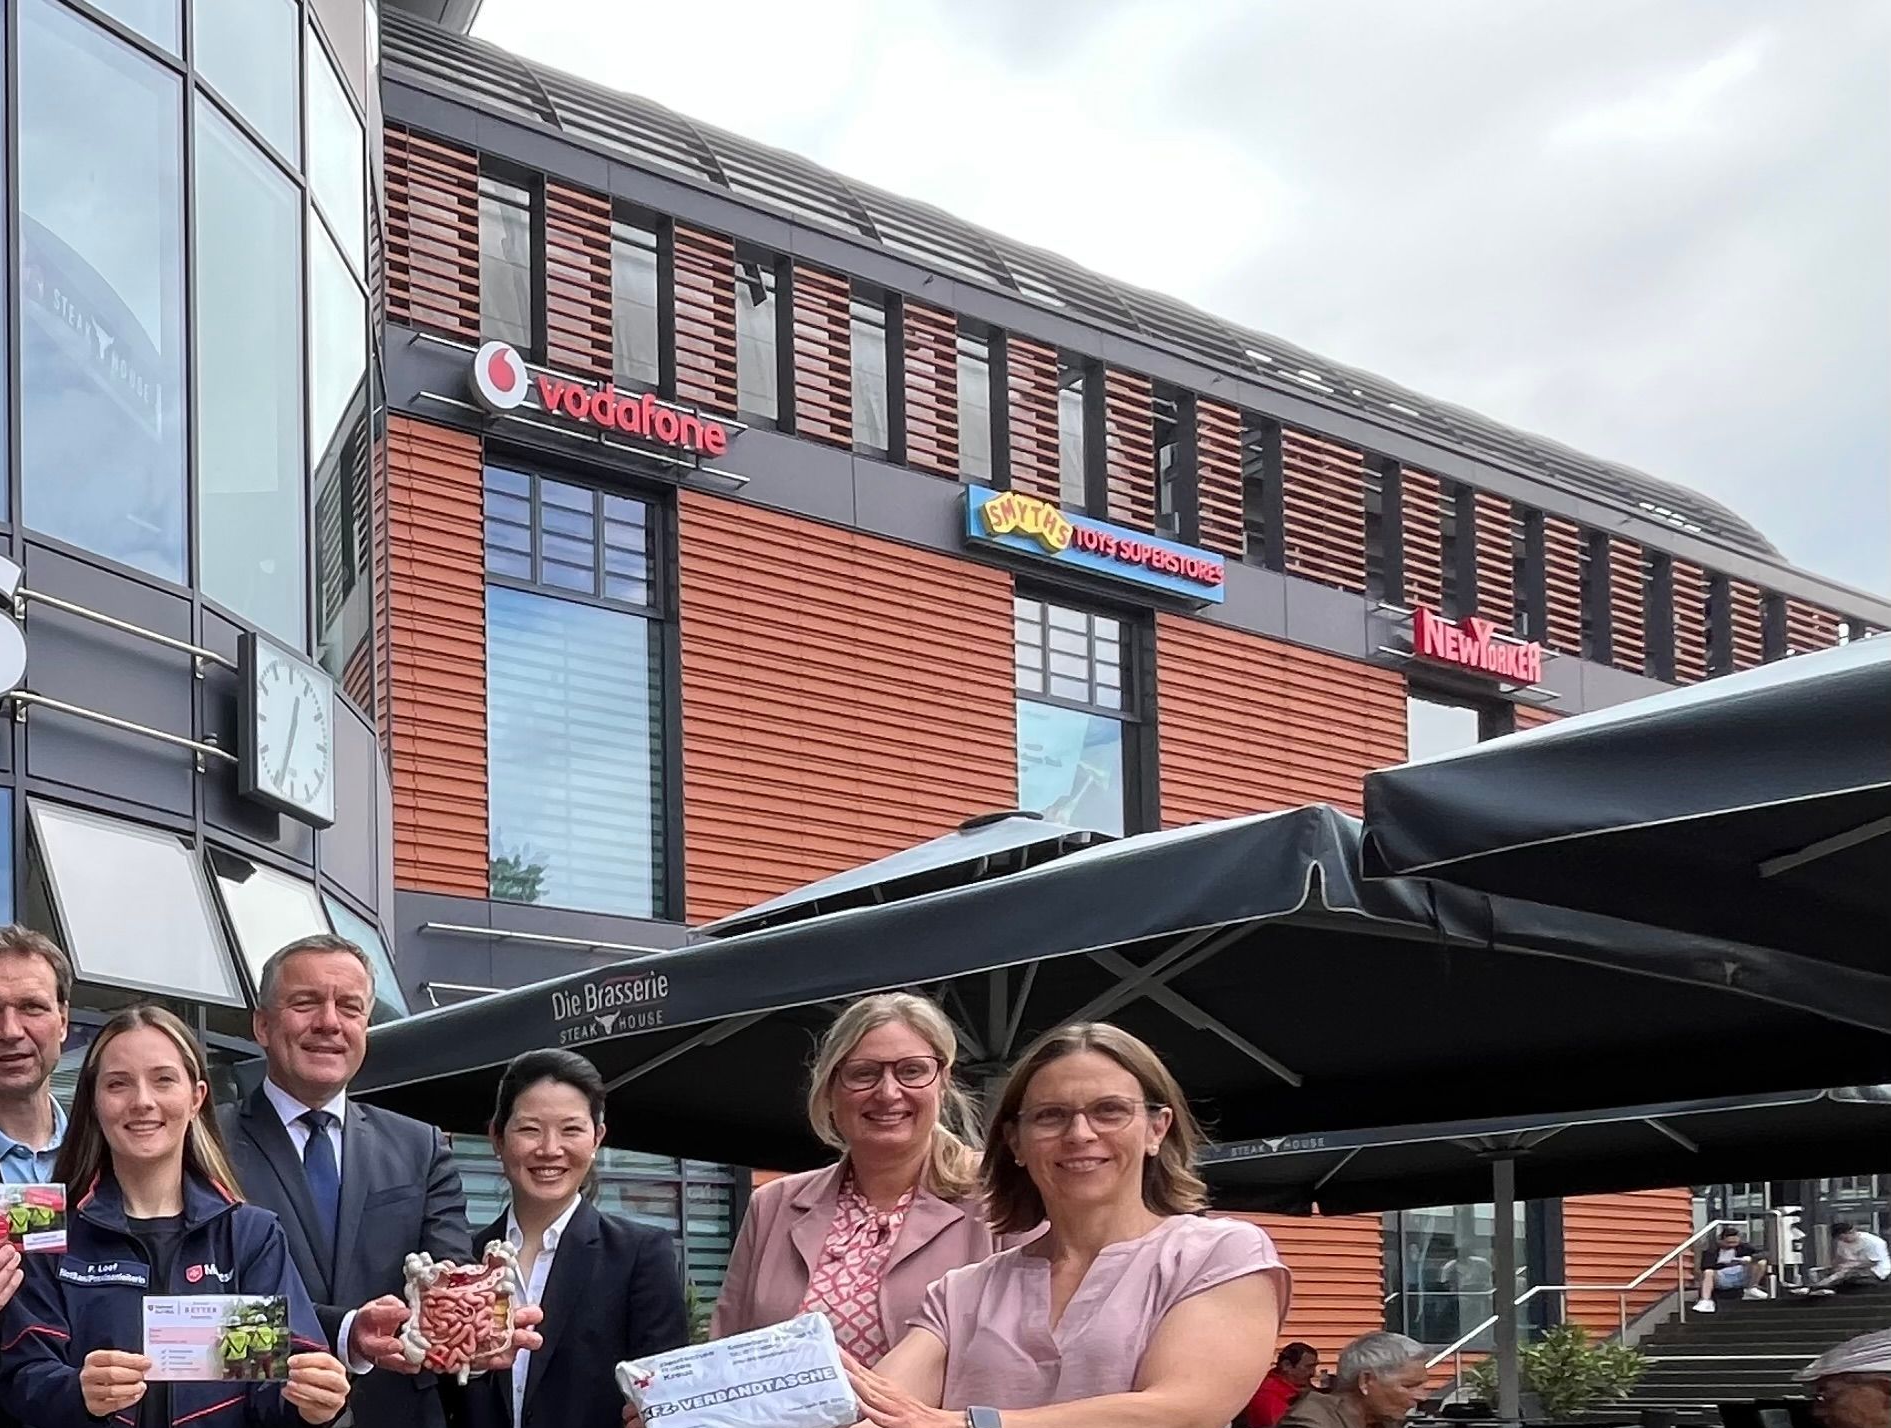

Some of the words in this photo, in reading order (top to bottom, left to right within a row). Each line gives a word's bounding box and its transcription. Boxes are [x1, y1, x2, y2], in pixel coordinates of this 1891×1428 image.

[535, 374, 728, 458] vodafone
[987, 498, 1072, 547] SMYTHS
[1074, 527, 1116, 556] TOYS
[1119, 540, 1225, 585] SUPERSTORES
[552, 991, 582, 1021] Die
[584, 971, 669, 1013] Brasserie
[560, 1022, 598, 1045] STEAK
[618, 1010, 663, 1030] HOUSE
[1231, 1144, 1265, 1157] STEAK
[1283, 1137, 1325, 1150] HOUSE
